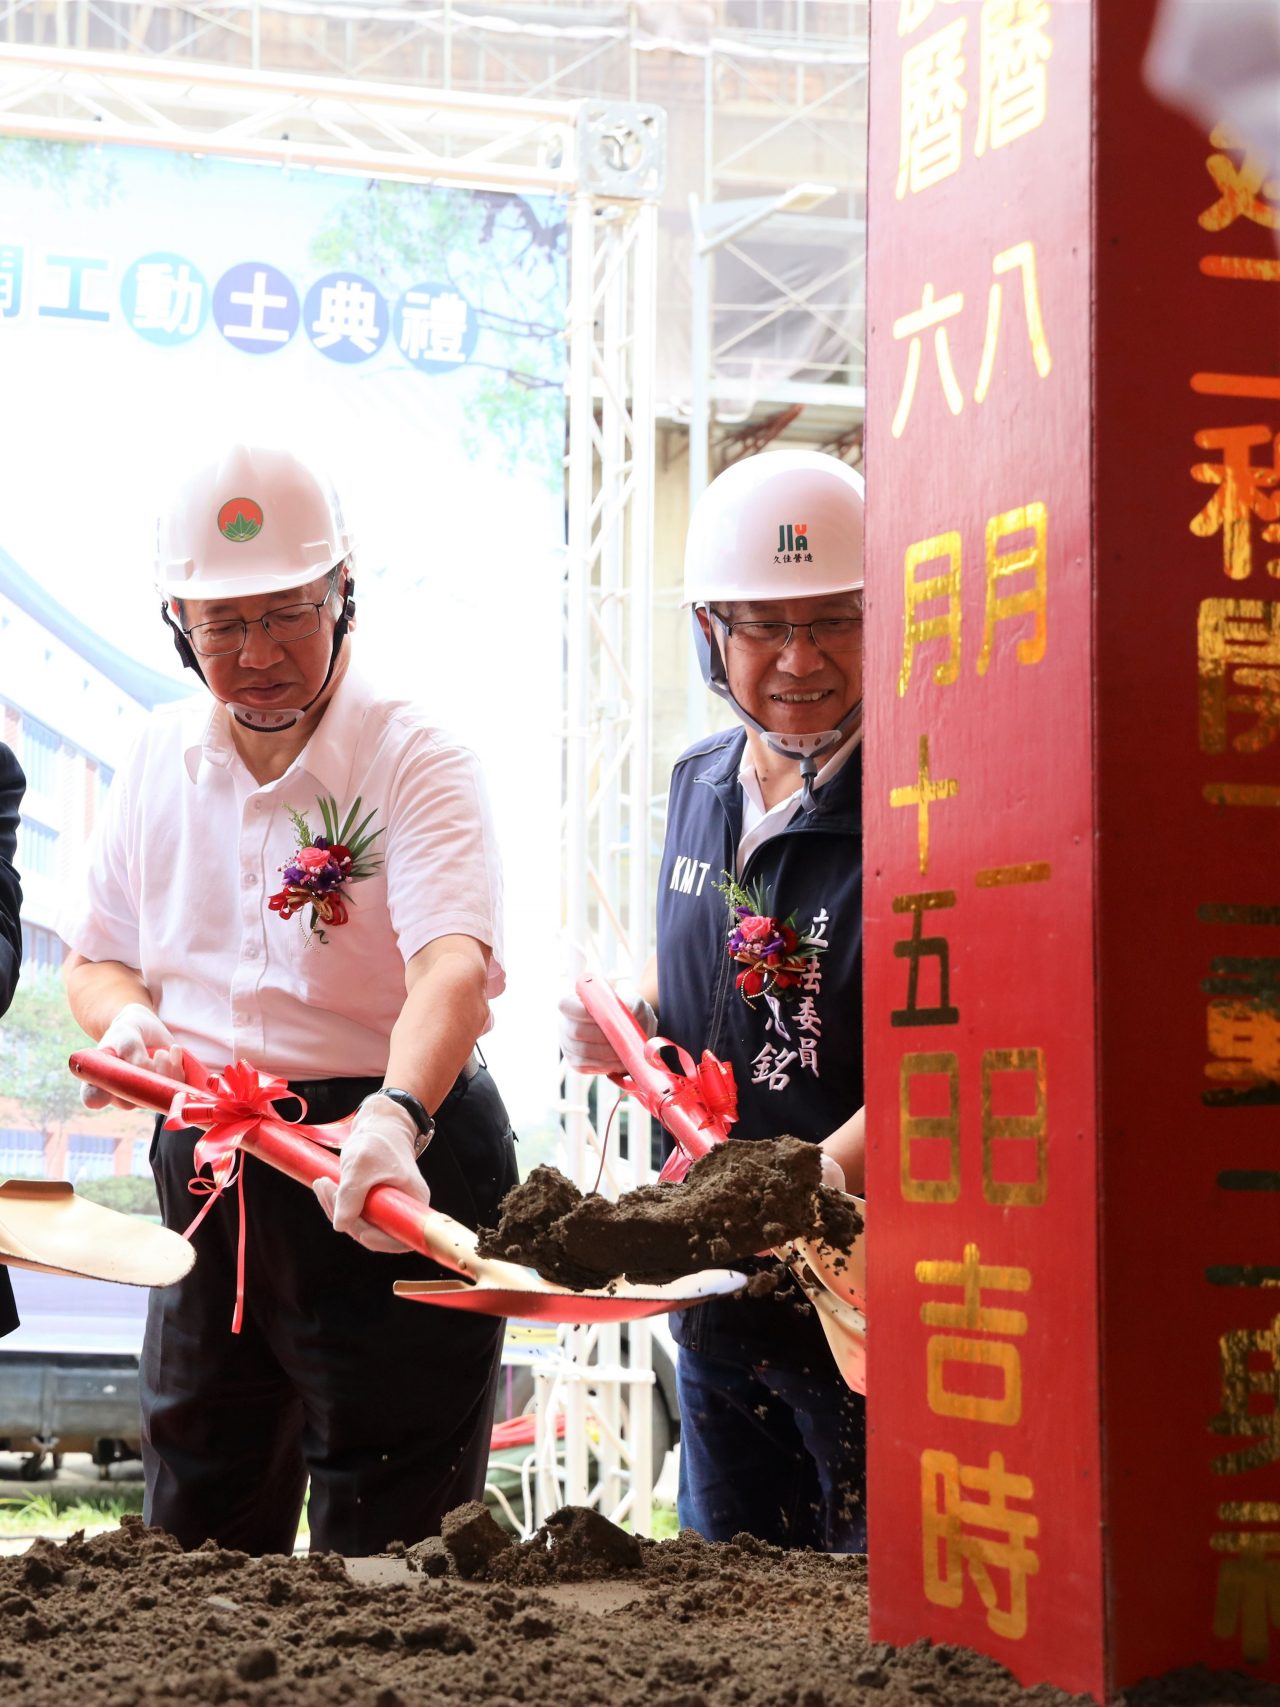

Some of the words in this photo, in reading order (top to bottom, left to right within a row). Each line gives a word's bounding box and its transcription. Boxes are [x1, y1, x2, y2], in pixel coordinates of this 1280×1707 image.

[773, 553, 813, 565] 久佳營造
[669, 855, 711, 897] KMT
[914, 1243, 1040, 1641] 吉時
